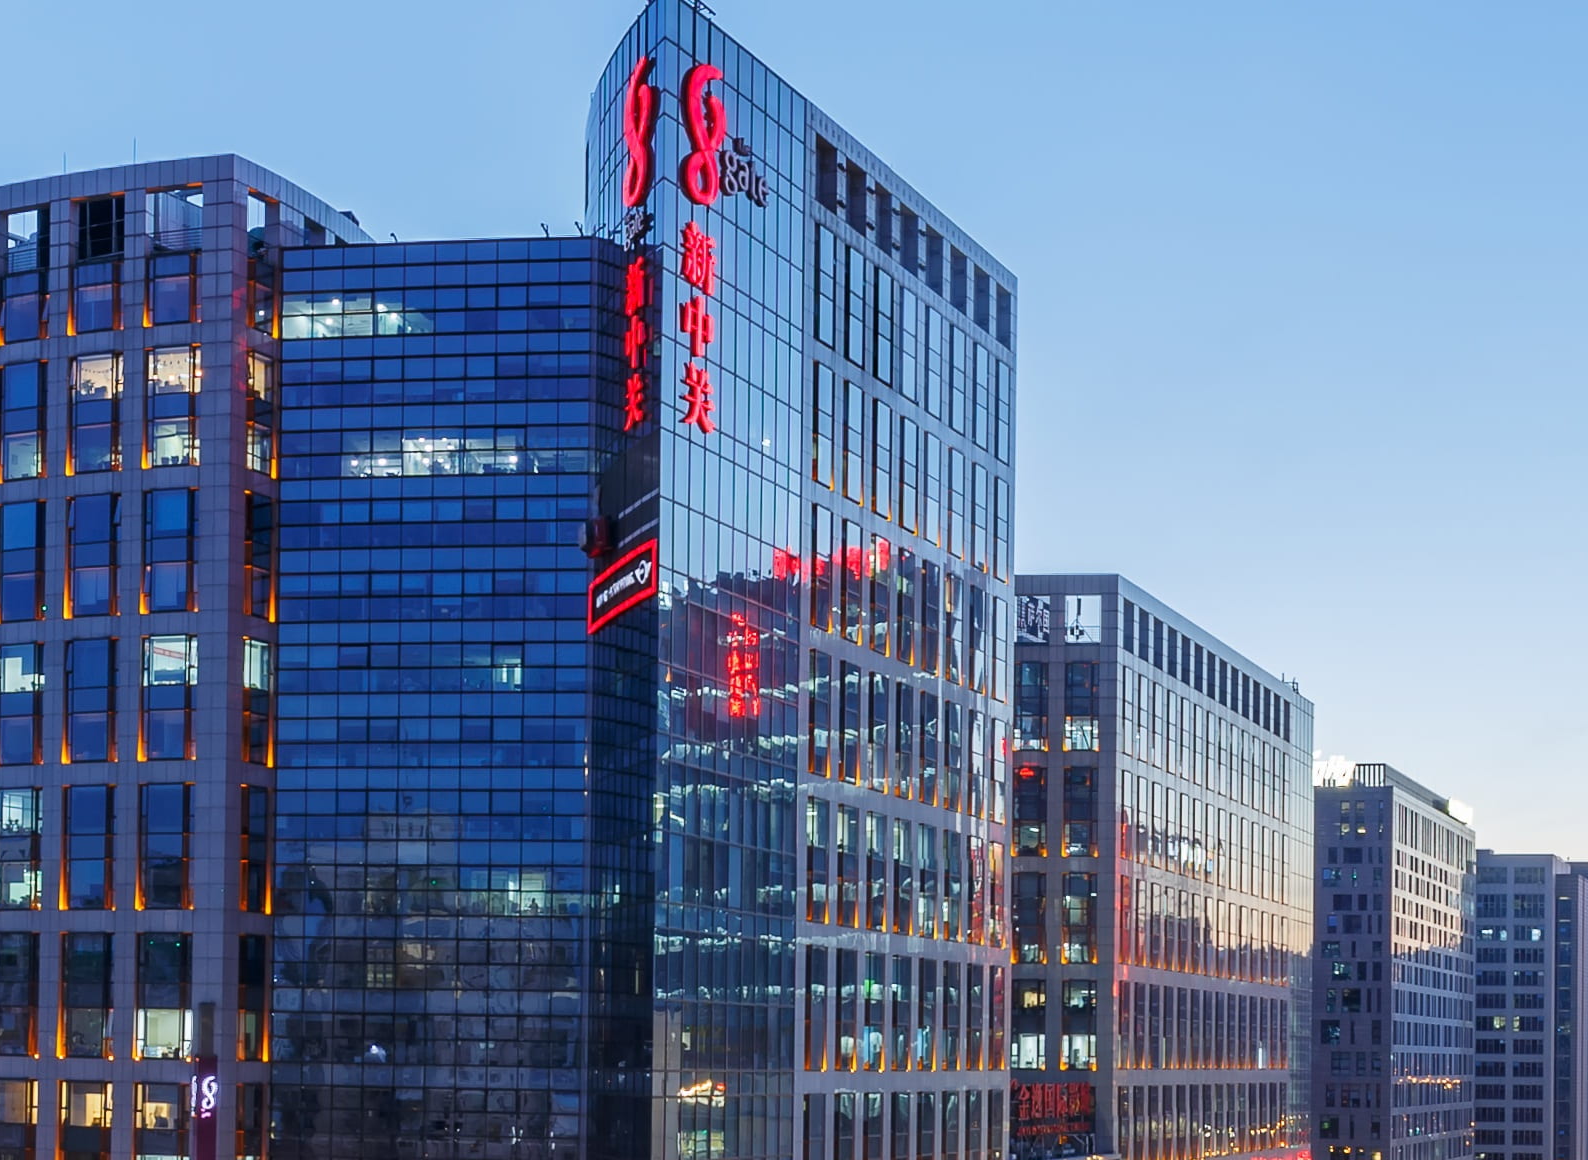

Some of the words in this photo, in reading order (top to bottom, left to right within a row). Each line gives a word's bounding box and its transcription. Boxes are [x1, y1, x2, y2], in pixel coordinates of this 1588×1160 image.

[720, 150, 770, 208] gate
[679, 221, 716, 434] 新中关
